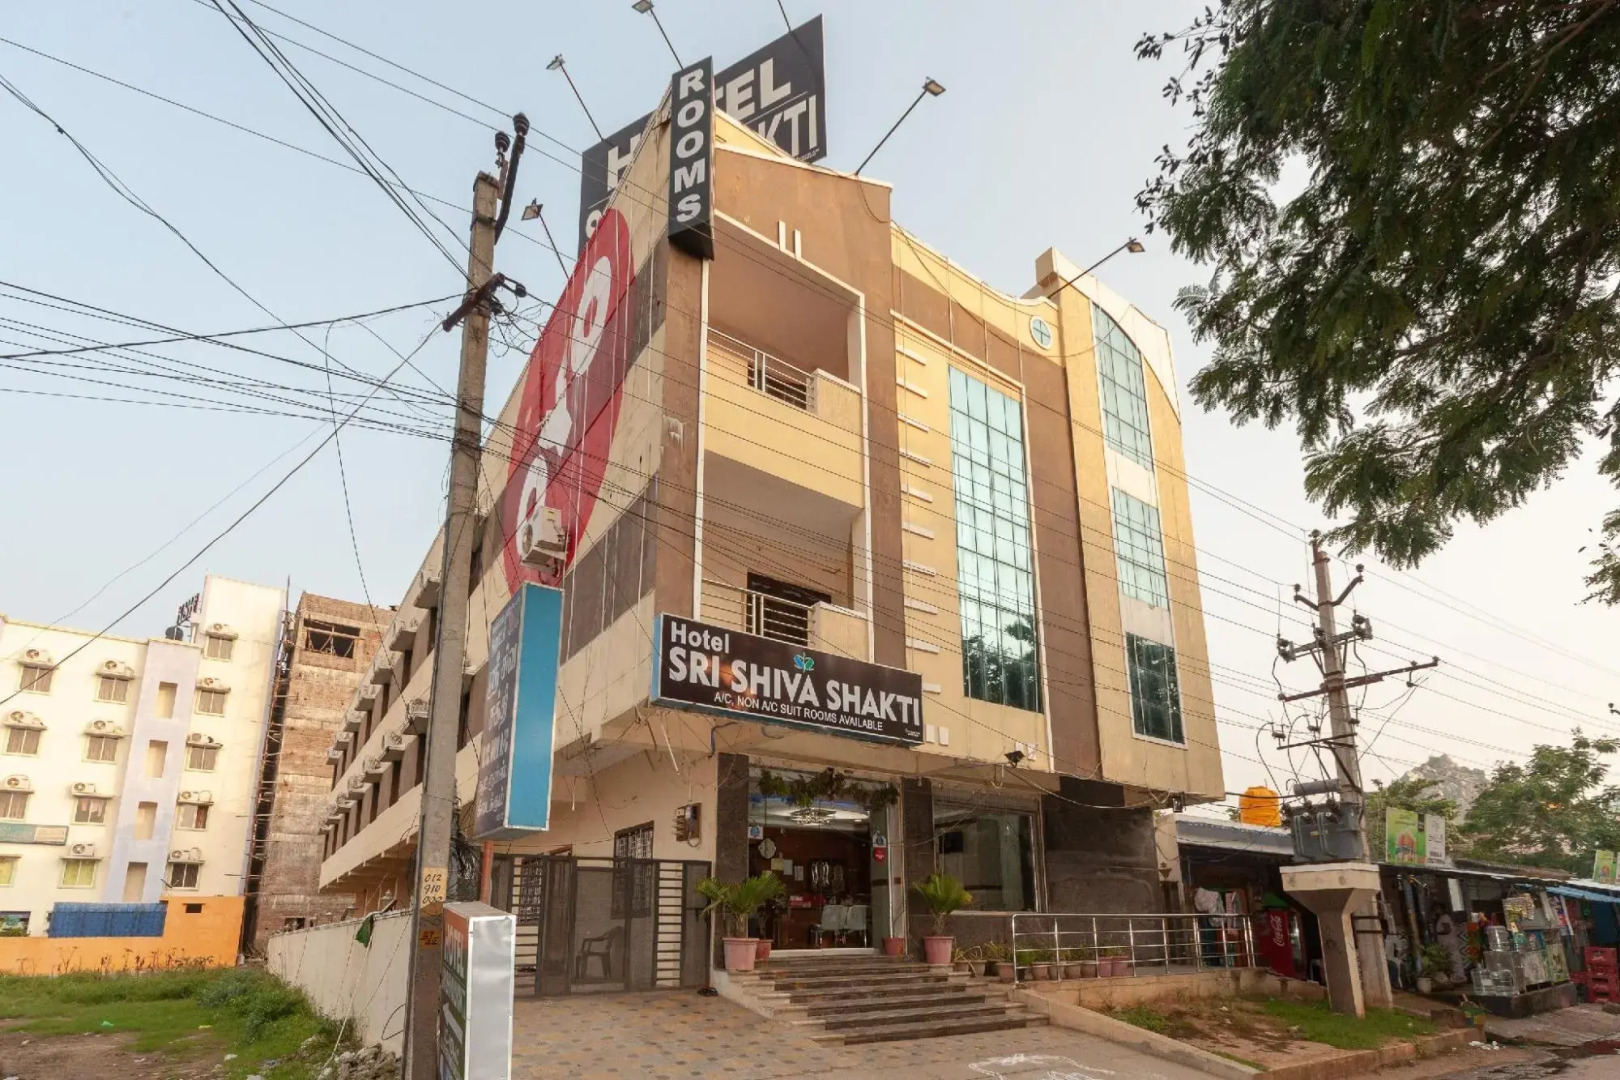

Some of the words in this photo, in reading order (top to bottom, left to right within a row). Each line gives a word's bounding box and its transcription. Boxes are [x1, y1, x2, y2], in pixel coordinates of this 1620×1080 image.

[674, 68, 705, 223] ROOMS
[671, 621, 730, 654] Hotel
[669, 646, 719, 688] SRI
[731, 659, 819, 707] SHIVA
[826, 679, 921, 726] SHAKTI
[737, 697, 760, 710] NON
[761, 701, 778, 713] A/C
[780, 704, 802, 717] SUIT
[804, 708, 837, 723] ROOMS
[839, 713, 883, 731] AVAILABLE
